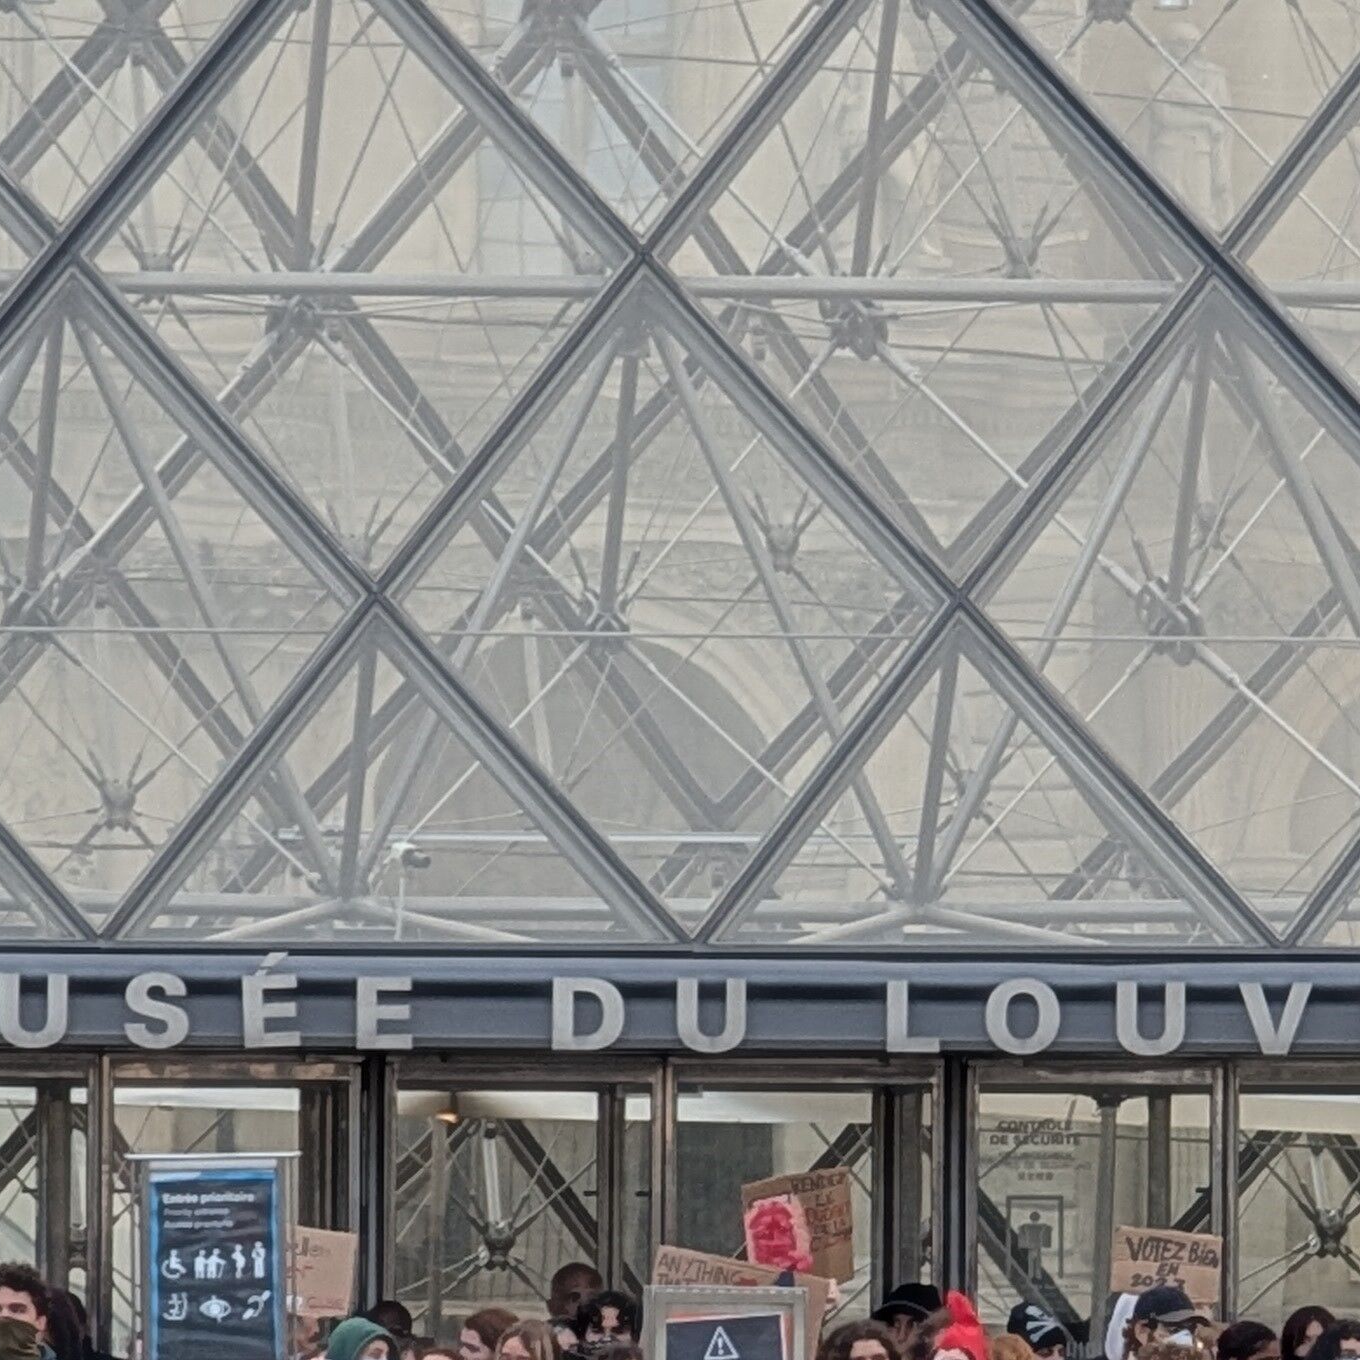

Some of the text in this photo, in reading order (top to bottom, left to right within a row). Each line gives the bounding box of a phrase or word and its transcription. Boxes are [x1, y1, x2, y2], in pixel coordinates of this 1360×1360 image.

[551, 977, 747, 1053] DU
[990, 1134, 1008, 1145] DE
[1126, 1236, 1187, 1262] VOTEZ
